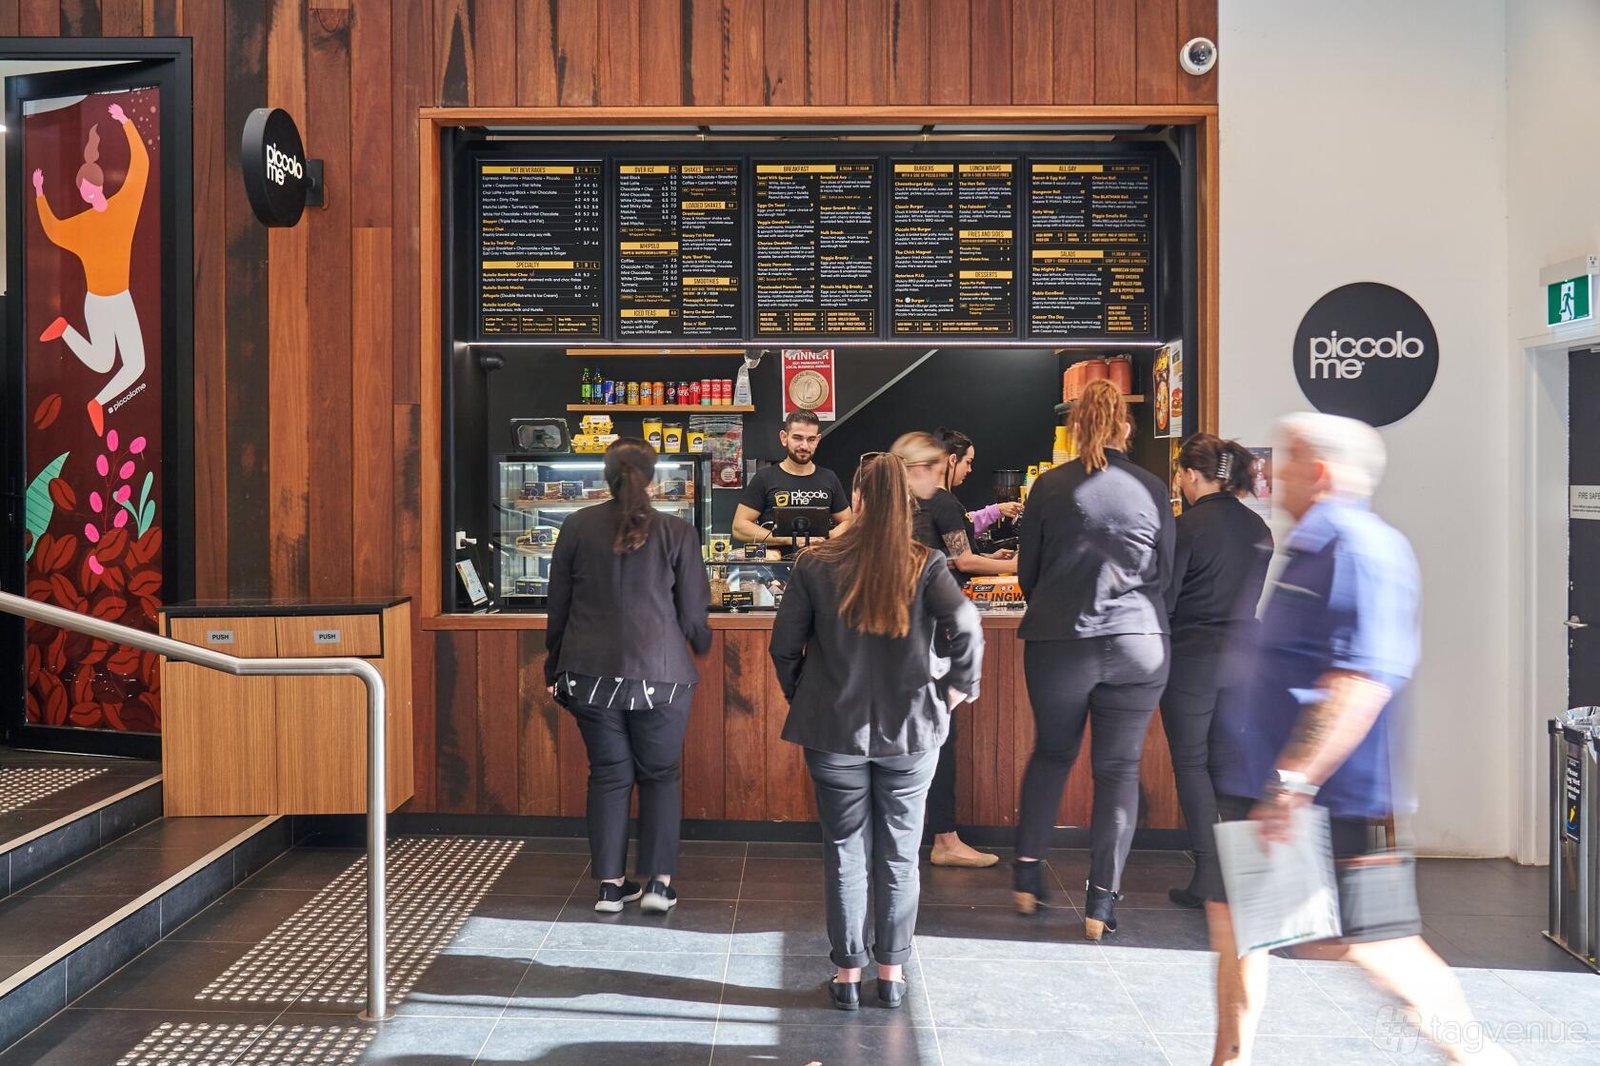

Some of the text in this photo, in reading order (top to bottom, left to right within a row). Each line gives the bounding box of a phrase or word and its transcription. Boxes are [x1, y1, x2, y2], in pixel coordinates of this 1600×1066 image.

[266, 143, 302, 179] piccolo
[267, 162, 285, 186] me
[1310, 330, 1424, 358] piccolo
[1310, 358, 1363, 379] me
[790, 490, 828, 500] piccolo
